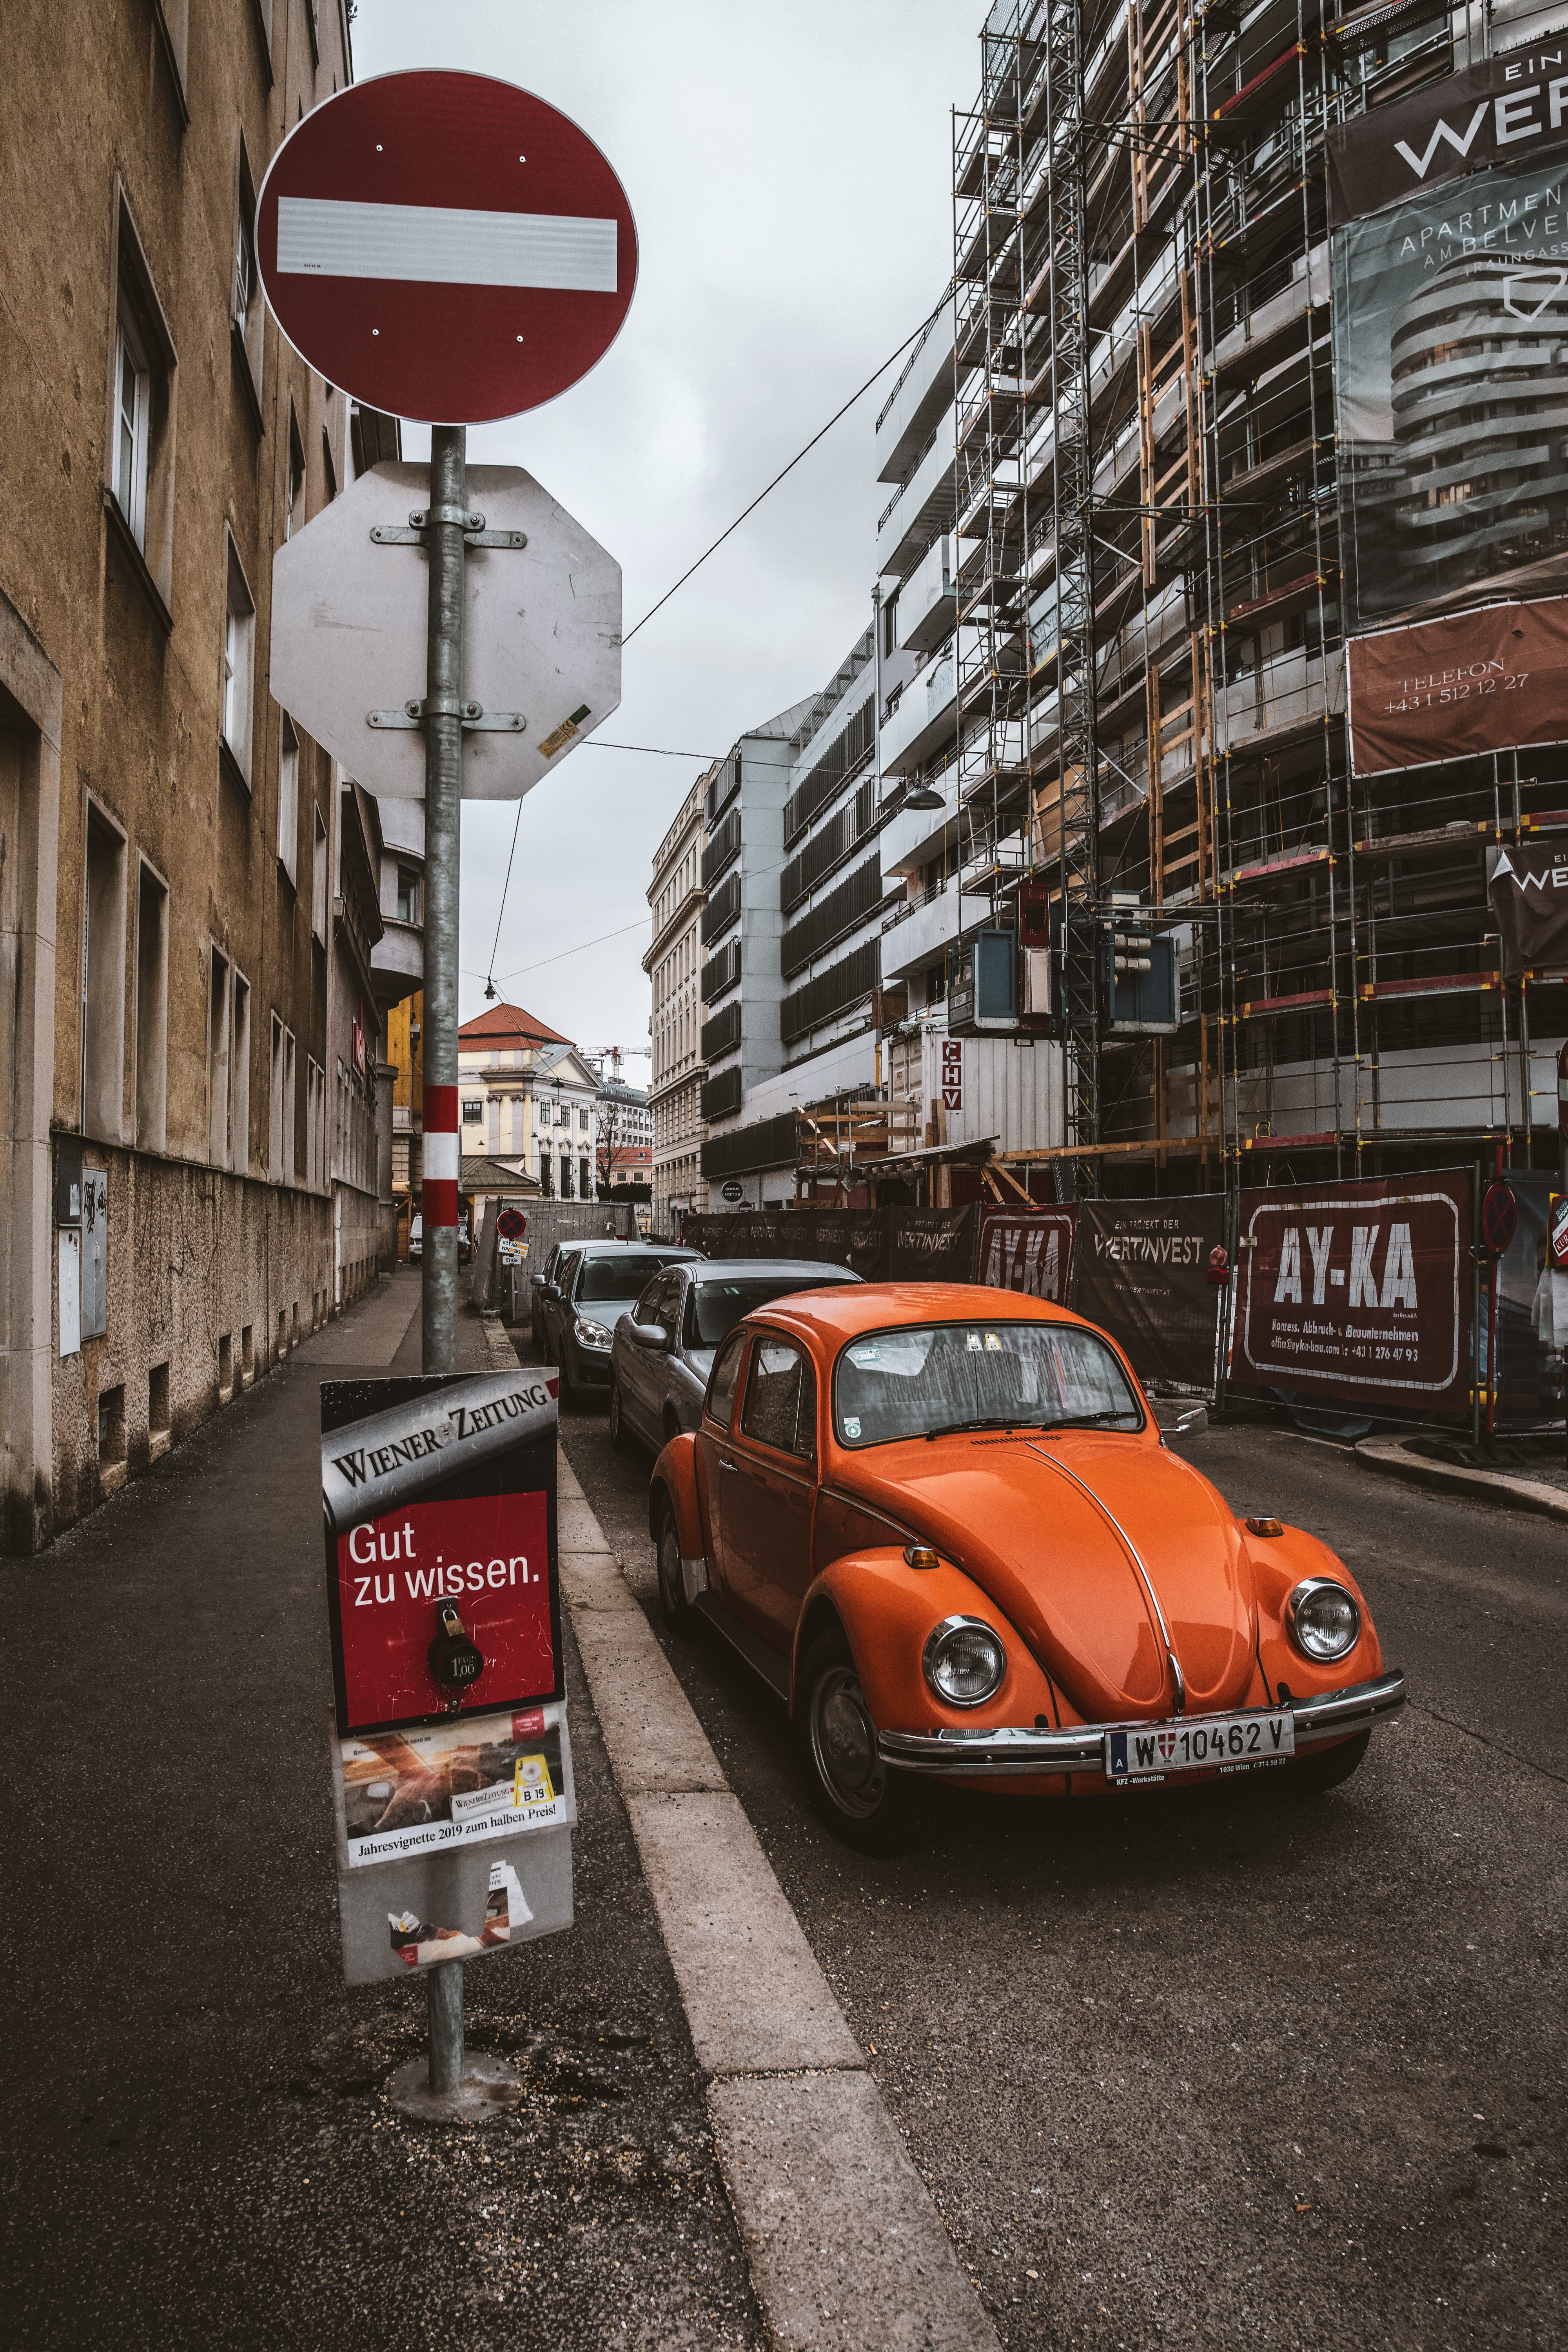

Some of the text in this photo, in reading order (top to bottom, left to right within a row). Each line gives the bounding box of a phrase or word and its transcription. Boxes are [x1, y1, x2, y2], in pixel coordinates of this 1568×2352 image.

[1505, 51, 1562, 81] EIN
[1424, 212, 1568, 269] AM BELVE
[1385, 673, 1528, 713] +43 1 512 12 27
[1401, 658, 1504, 693] TELEFON
[1115, 1220, 1179, 1230] EIN PROJEKT DER
[985, 1229, 1059, 1299] AY-KA
[1094, 1233, 1204, 1264] WERTINVEST
[1274, 1223, 1417, 1308] AY-KA
[1352, 1345, 1366, 1358] +43
[1375, 1347, 1390, 1360] 276
[1393, 1348, 1403, 1361] 47
[1405, 1348, 1418, 1361] 93
[332, 1385, 548, 1488] WIENER ZEITUNG
[349, 1522, 416, 1564] Gut
[354, 1555, 539, 1606] zu wissen.
[1135, 1718, 1283, 1767] W 10462 V
[1116, 1759, 1123, 1768] A
[1129, 1775, 1165, 1784] -Werkstätte
[455, 1797, 480, 1809] WIENER
[482, 1788, 510, 1800] ZEITUNG
[524, 1788, 544, 1801] B 19
[358, 1804, 556, 1857] Jahresvignette 2019 zum halben Preis!
